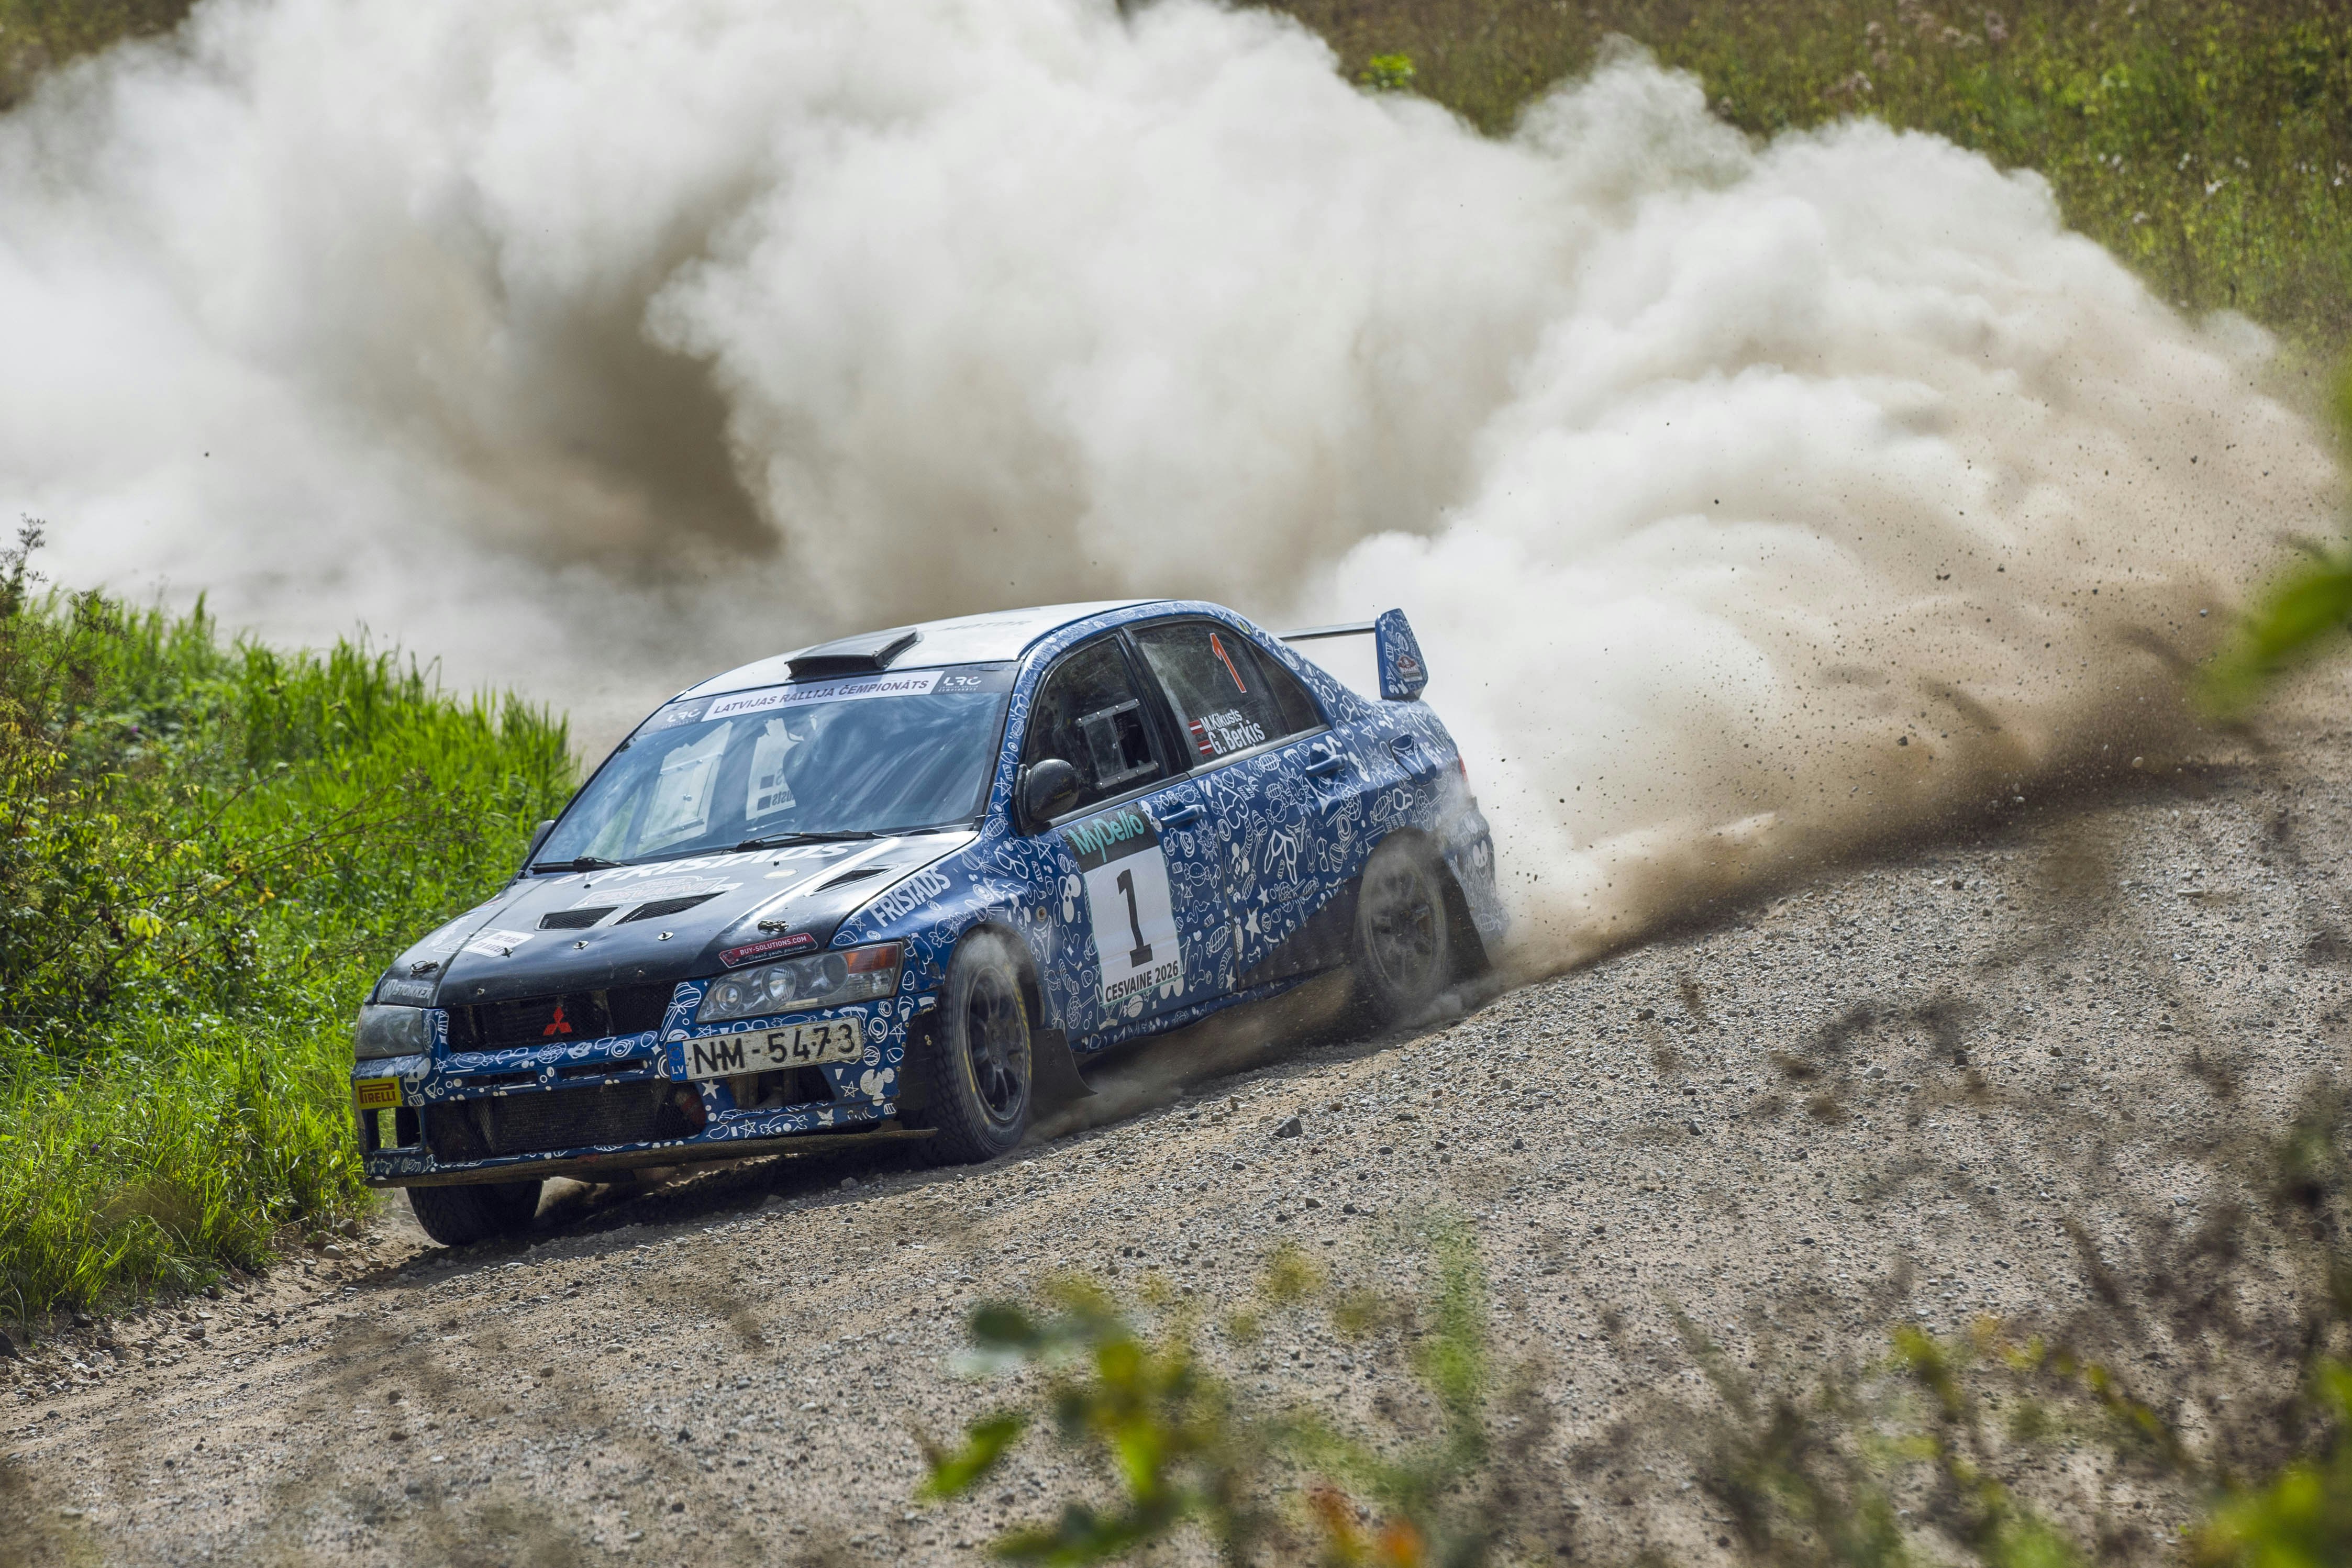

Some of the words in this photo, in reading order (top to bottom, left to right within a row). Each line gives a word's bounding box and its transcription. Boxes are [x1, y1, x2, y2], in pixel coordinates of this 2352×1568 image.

[1210, 632, 1247, 693] 1
[714, 696, 777, 714] LATVIJAS
[779, 688, 835, 703] RALLIJA
[838, 680, 929, 695] ČEMPIONĀTS
[1208, 731, 1227, 754] G.
[1067, 810, 1145, 863] MyDello
[590, 842, 859, 883] FRISTADS
[867, 866, 951, 927] FRISTADS
[1116, 868, 1153, 968] 1
[740, 936, 807, 955] BUY-SOLUTIONS.COM
[784, 945, 807, 954] passion
[393, 984, 434, 999] STOKKER
[1105, 970, 1152, 1003] CESVAINE
[1155, 960, 1179, 984] 2026
[693, 1024, 856, 1074] NM-5473
[672, 1065, 684, 1074] LV
[358, 1083, 396, 1104] PIRELLI
